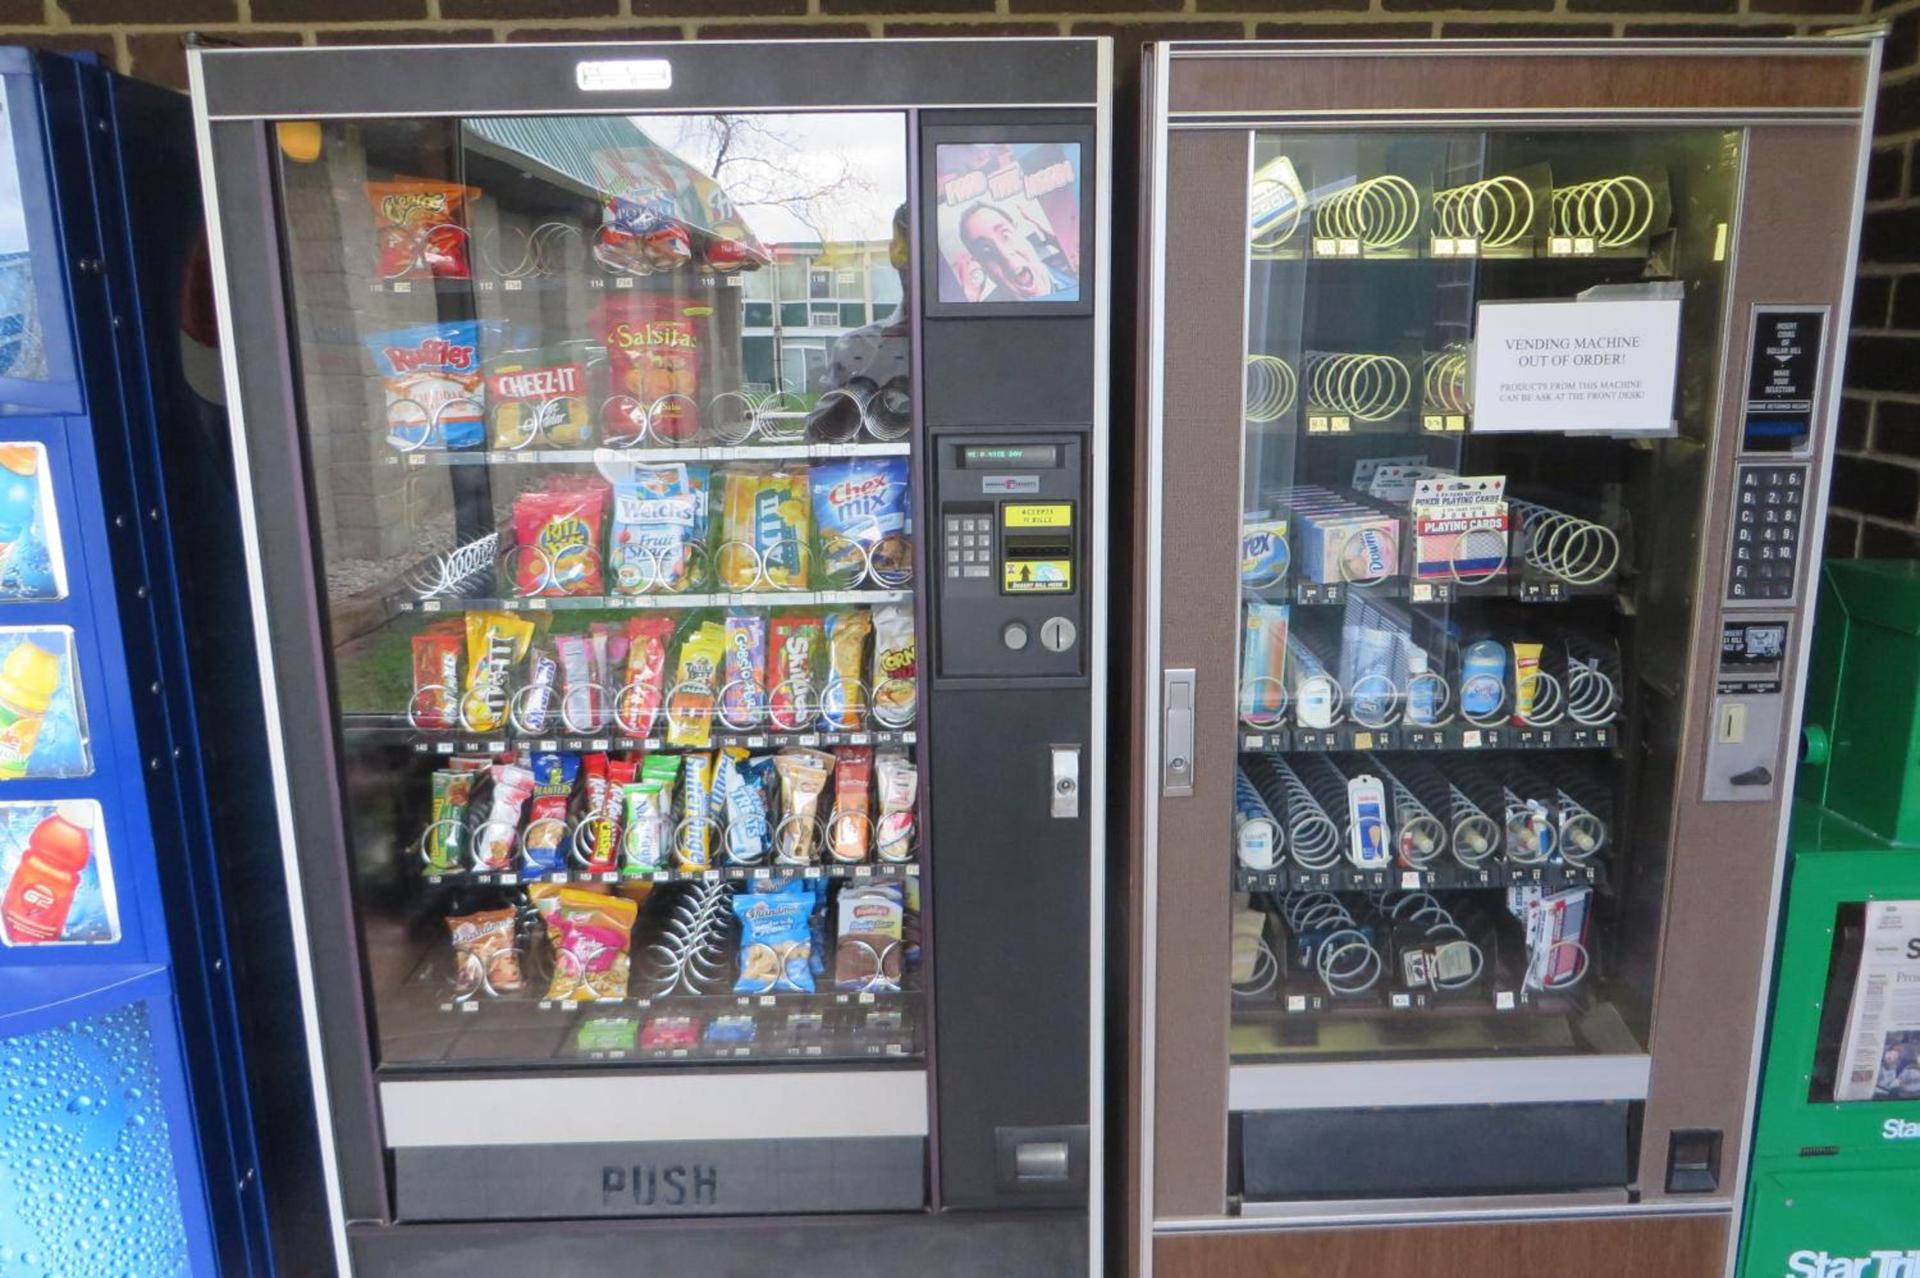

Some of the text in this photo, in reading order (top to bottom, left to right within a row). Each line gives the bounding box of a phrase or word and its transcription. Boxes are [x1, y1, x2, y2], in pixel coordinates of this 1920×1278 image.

[1505, 336, 1641, 350] VENDING MACHINE
[384, 338, 475, 372] Ruffles
[1518, 353, 1626, 367] OUT OF ORDER!
[499, 367, 576, 397] CHEEZ-IT
[1500, 380, 1641, 391] PRODUCTS FROM THIS MACHINE
[1499, 394, 1519, 402] CAN
[1535, 393, 1551, 401] ASK
[1568, 392, 1584, 400] THE
[1587, 391, 1617, 400] FRONT
[1745, 473, 1752, 485] A
[1772, 473, 1777, 485] 1
[1789, 472, 1796, 484] 6
[828, 473, 887, 506] Chex
[1442, 496, 1473, 505] PLAYING
[1743, 492, 1751, 504] B
[1768, 492, 1776, 504] 2
[1787, 491, 1794, 503] 7
[838, 488, 888, 521] mix
[1741, 510, 1749, 522] C
[1766, 510, 1774, 521] 3
[1784, 510, 1792, 521] 8
[1424, 518, 1502, 533] PLAYING CARDS
[1764, 528, 1771, 539] 4
[1783, 528, 1790, 539] 9
[1738, 547, 1746, 559] E
[1763, 547, 1770, 559] 5
[1780, 547, 1790, 558] 10
[1736, 565, 1743, 576] F
[1734, 583, 1742, 595] G
[23, 888, 55, 909] G2
[602, 1164, 717, 1206] PUSH
